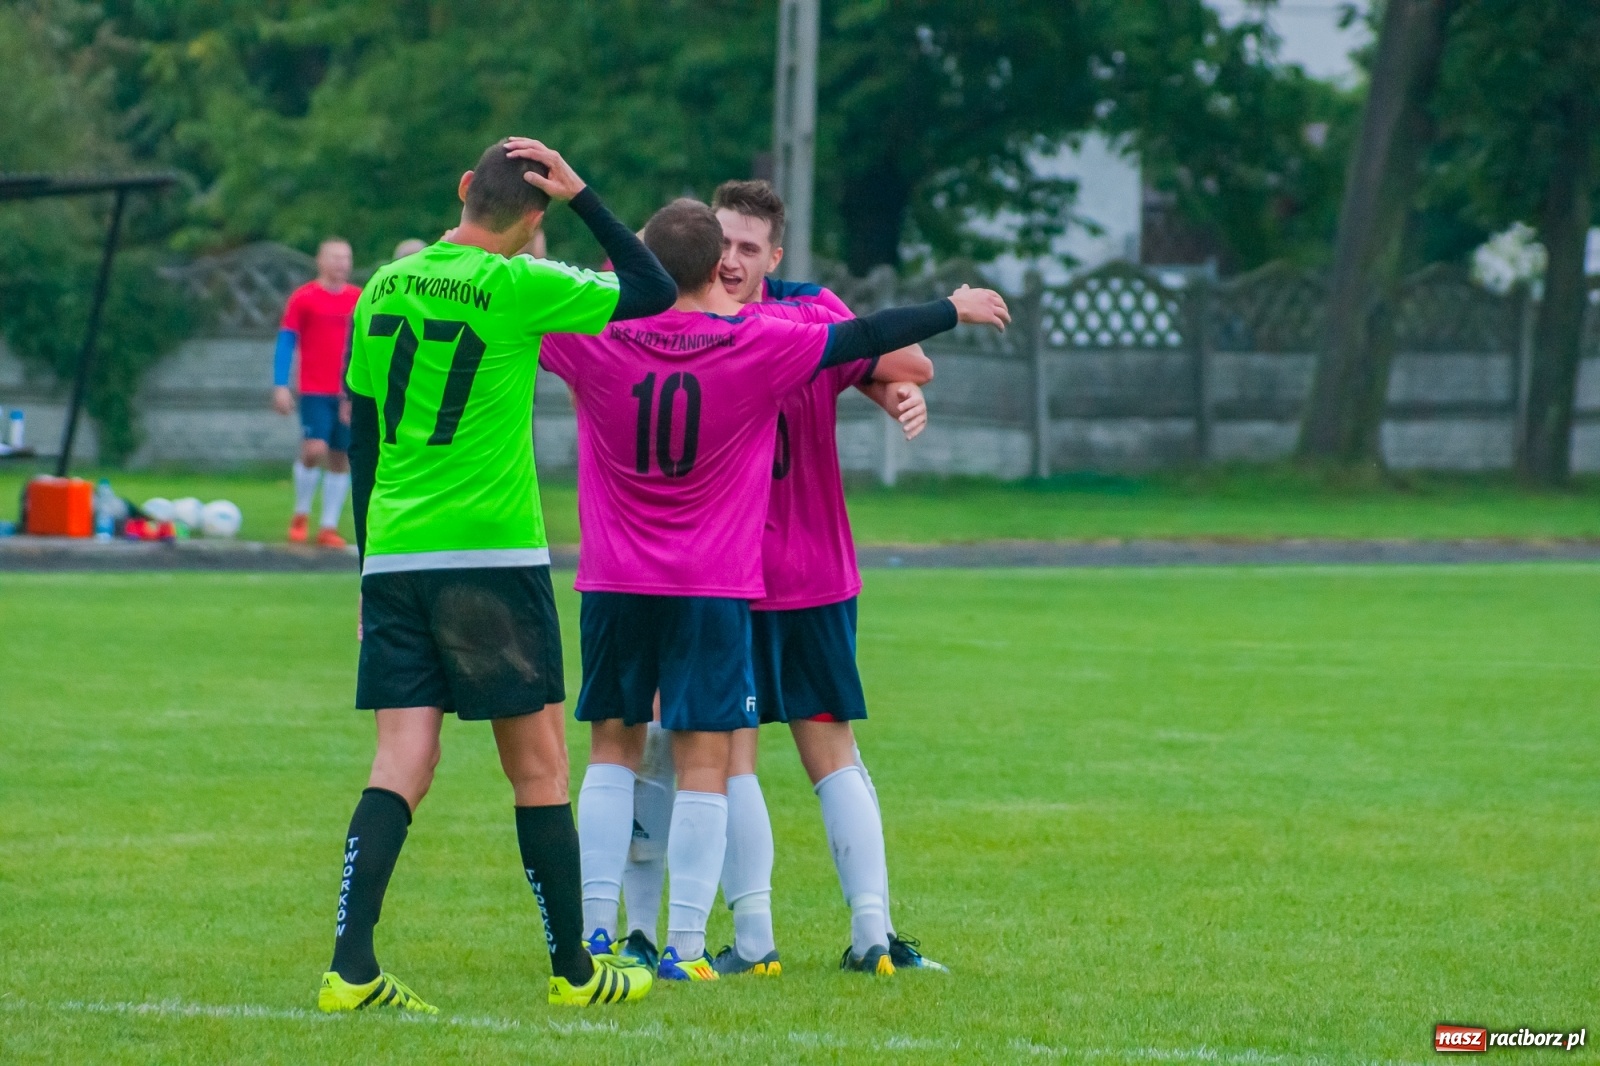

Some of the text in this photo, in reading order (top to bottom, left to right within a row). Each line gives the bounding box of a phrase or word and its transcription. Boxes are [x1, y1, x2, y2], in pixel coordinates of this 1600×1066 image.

[371, 275, 492, 311] LKS TWORKÓW
[368, 313, 487, 446] 77
[632, 371, 702, 478] 10
